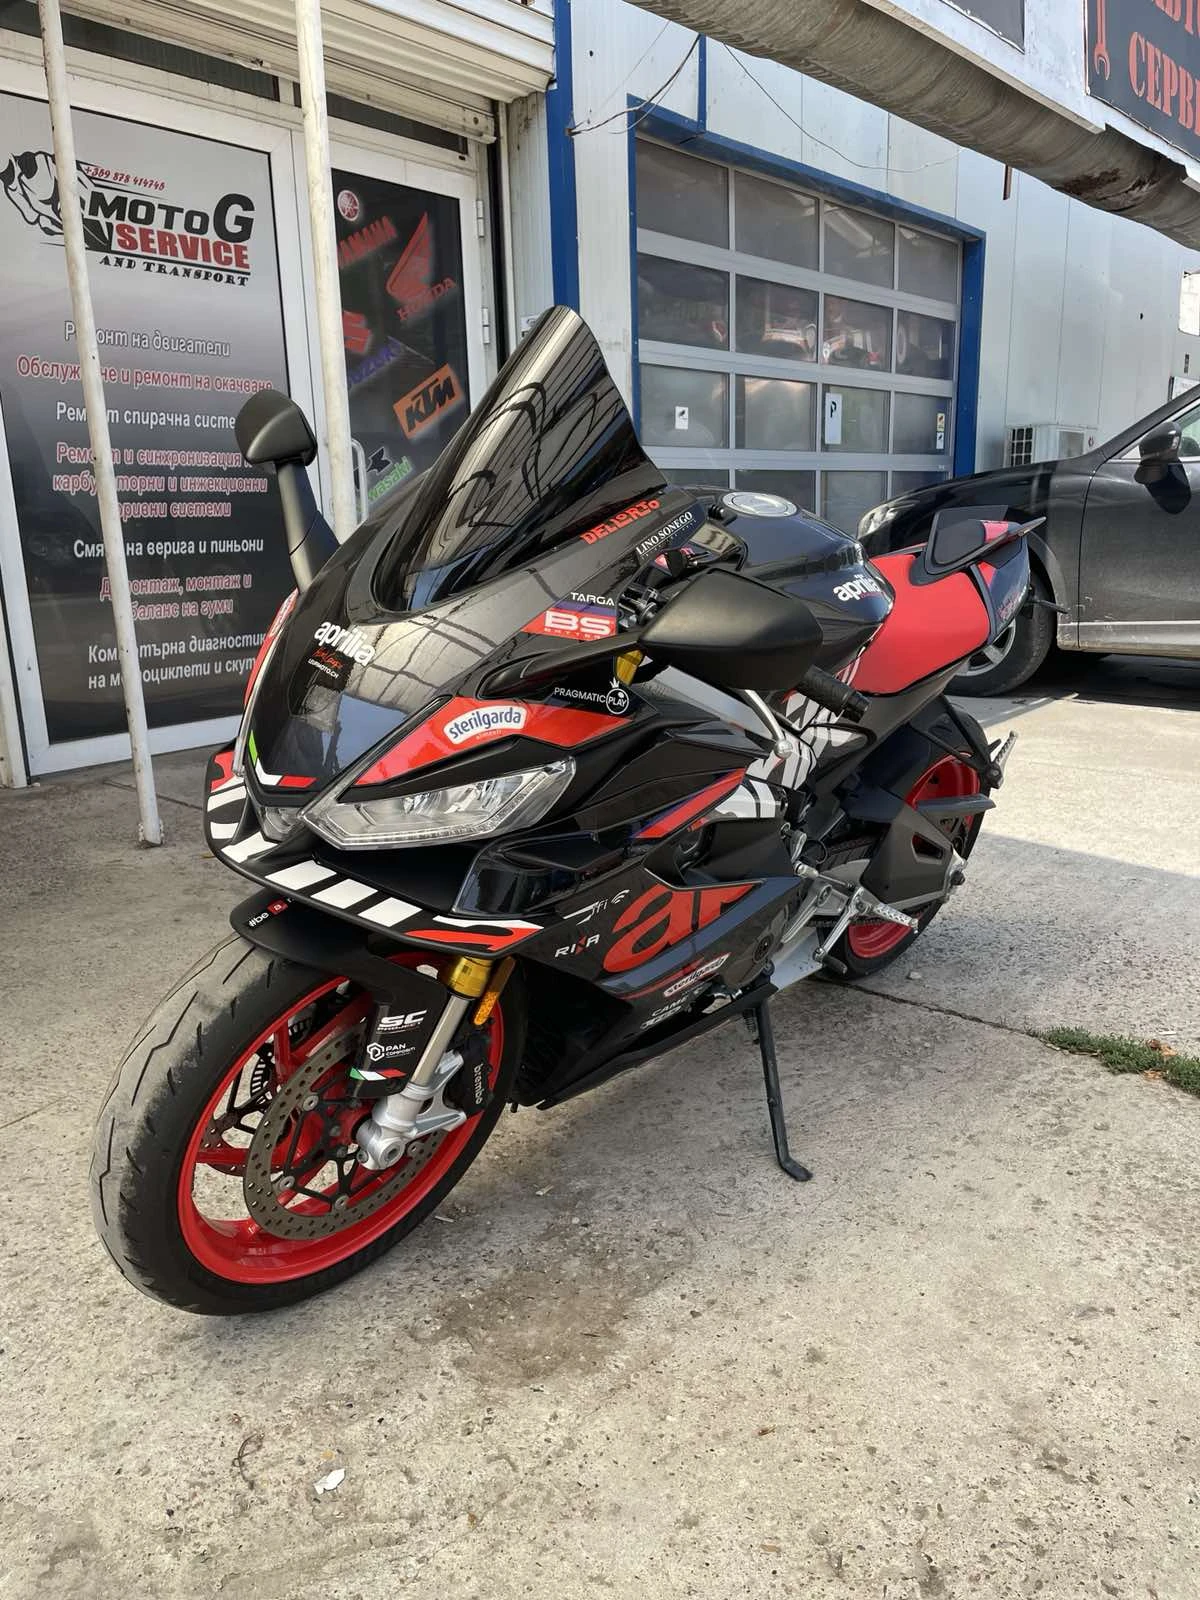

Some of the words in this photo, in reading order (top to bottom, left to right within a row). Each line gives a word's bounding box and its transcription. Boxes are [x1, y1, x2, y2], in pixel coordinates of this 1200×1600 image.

[1129, 31, 1200, 137] СЕРВ
[115, 222, 250, 268] SERVICE
[99, 254, 136, 270] AND
[142, 261, 249, 287] TRANSPORT
[64, 320, 129, 348] Ронт
[132, 332, 150, 350] на
[152, 330, 232, 358] двигатели
[17, 354, 118, 385] Обслужне
[121, 367, 130, 384] и
[133, 370, 192, 390] ремонт
[195, 373, 211, 391] на
[56, 400, 120, 424] Ремт
[123, 410, 191, 430] спирачна
[194, 413, 236, 430] систе
[405, 376, 457, 433] KTM
[123, 448, 134, 465] и
[136, 448, 242, 472] синхронизация
[53, 470, 165, 497] карбуторни
[167, 474, 178, 491] и
[180, 473, 268, 497] инжекционни
[169, 501, 232, 519] системи
[636, 535, 659, 555] LINO
[657, 511, 693, 540] SONEGO
[74, 539, 104, 558] Смя
[126, 541, 143, 556] на
[147, 541, 195, 560] верига
[198, 539, 209, 554] и
[210, 537, 264, 554] пиньони
[100, 576, 184, 602] Донтаж,
[186, 575, 241, 593] монтаж
[242, 574, 252, 589] и
[570, 591, 615, 606] TARGA
[833, 574, 881, 602] aprilia
[181, 603, 199, 619] на
[200, 599, 234, 620] гуми
[545, 610, 611, 636] BS
[88, 640, 186, 664] Комтърна
[189, 633, 267, 655] диагностик
[314, 621, 376, 667] aprilia
[88, 673, 106, 689] на
[110, 662, 211, 687] моциклети
[214, 664, 223, 677] и
[225, 657, 257, 675] скут
[554, 687, 606, 704] PRAGMATIC
[608, 696, 627, 708] PLAY
[449, 706, 521, 740] sterilgarda
[379, 1009, 428, 1028] SC
[386, 1043, 406, 1052] PAN
[473, 1063, 484, 1105] brembo
